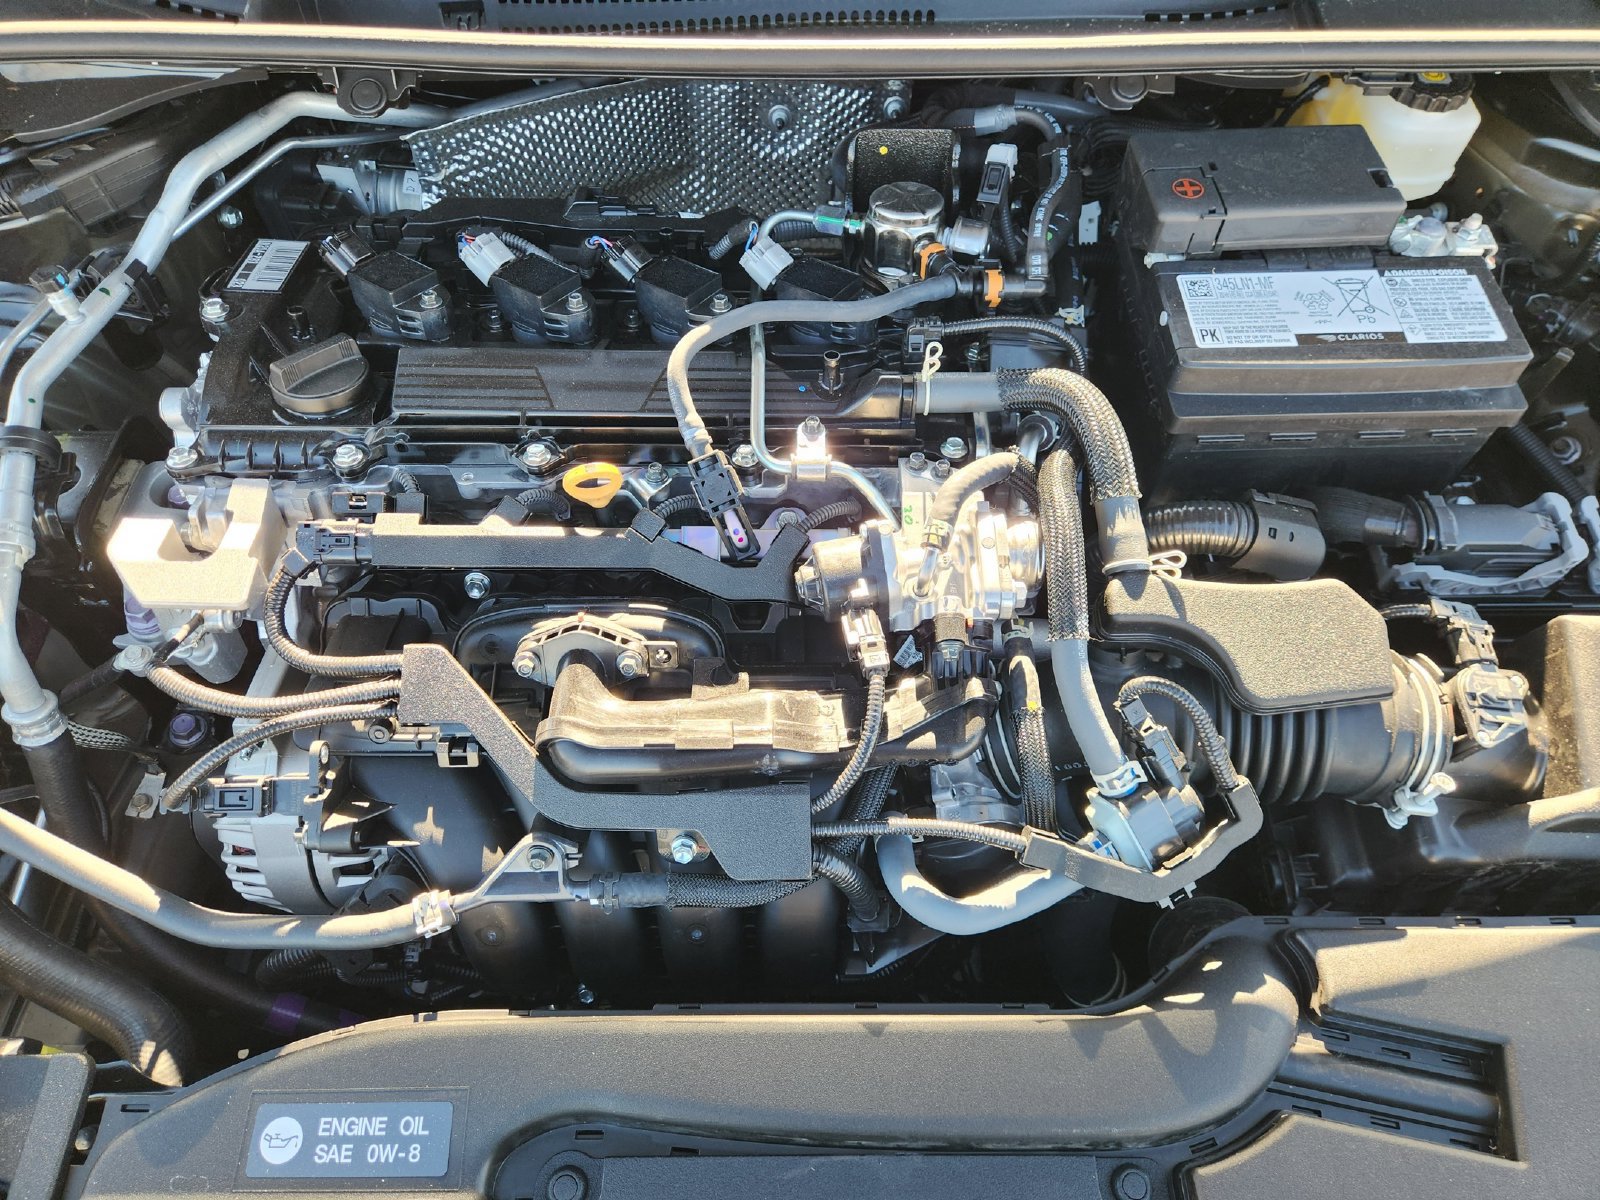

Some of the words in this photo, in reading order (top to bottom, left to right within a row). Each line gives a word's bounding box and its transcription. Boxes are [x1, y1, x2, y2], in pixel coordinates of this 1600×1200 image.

[1390, 268, 1468, 276] DANGER/POISON
[1214, 276, 1275, 291] 345LN1-MF
[1357, 314, 1377, 324] Pb
[1200, 328, 1221, 343] PK
[1337, 333, 1385, 341] CLARIOS
[318, 1117, 388, 1137] ENGINE
[400, 1116, 430, 1136] OIL
[314, 1144, 353, 1164] SAE
[366, 1144, 421, 1163] 0W-8
